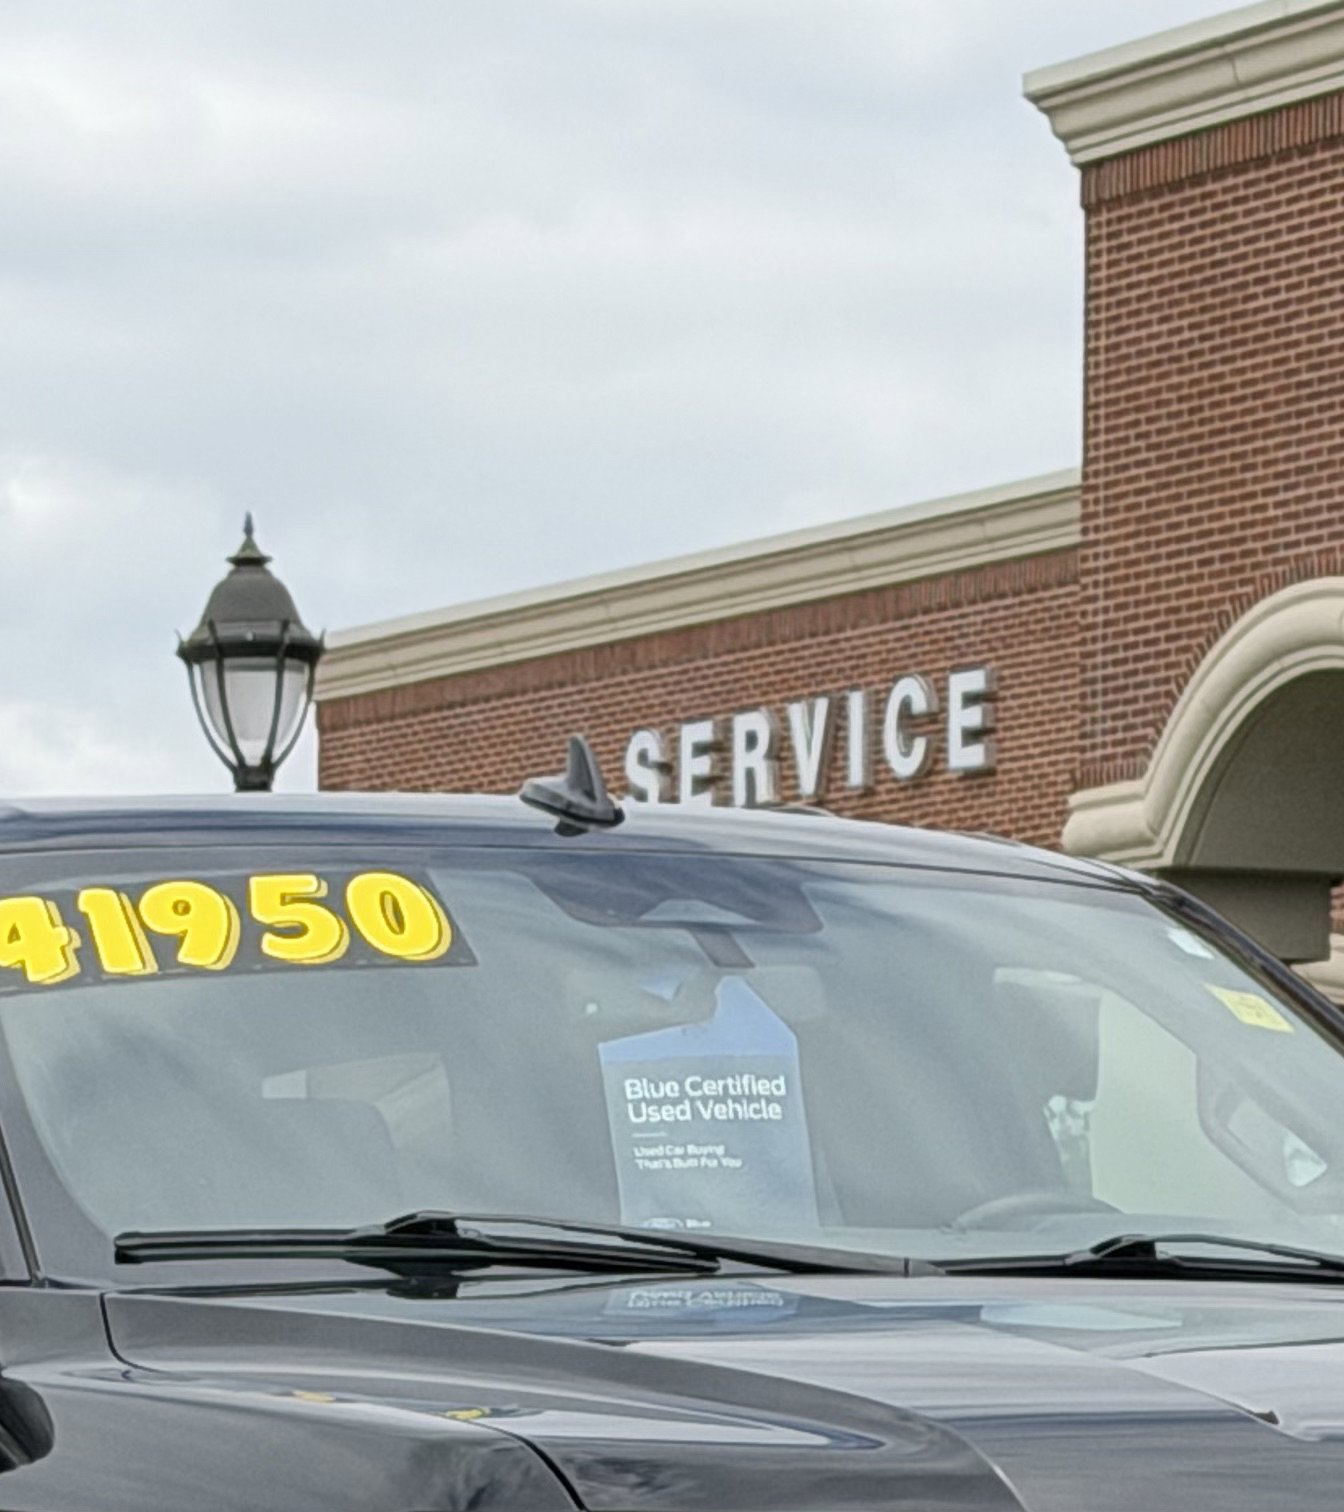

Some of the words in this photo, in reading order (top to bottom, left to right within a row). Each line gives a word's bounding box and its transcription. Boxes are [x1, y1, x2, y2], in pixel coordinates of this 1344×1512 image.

[623, 666, 996, 807] SERVICE
[624, 1078, 680, 1099] Blue
[684, 1074, 786, 1096] Certified
[628, 1100, 691, 1123] Used
[696, 1099, 782, 1120] Vehicle
